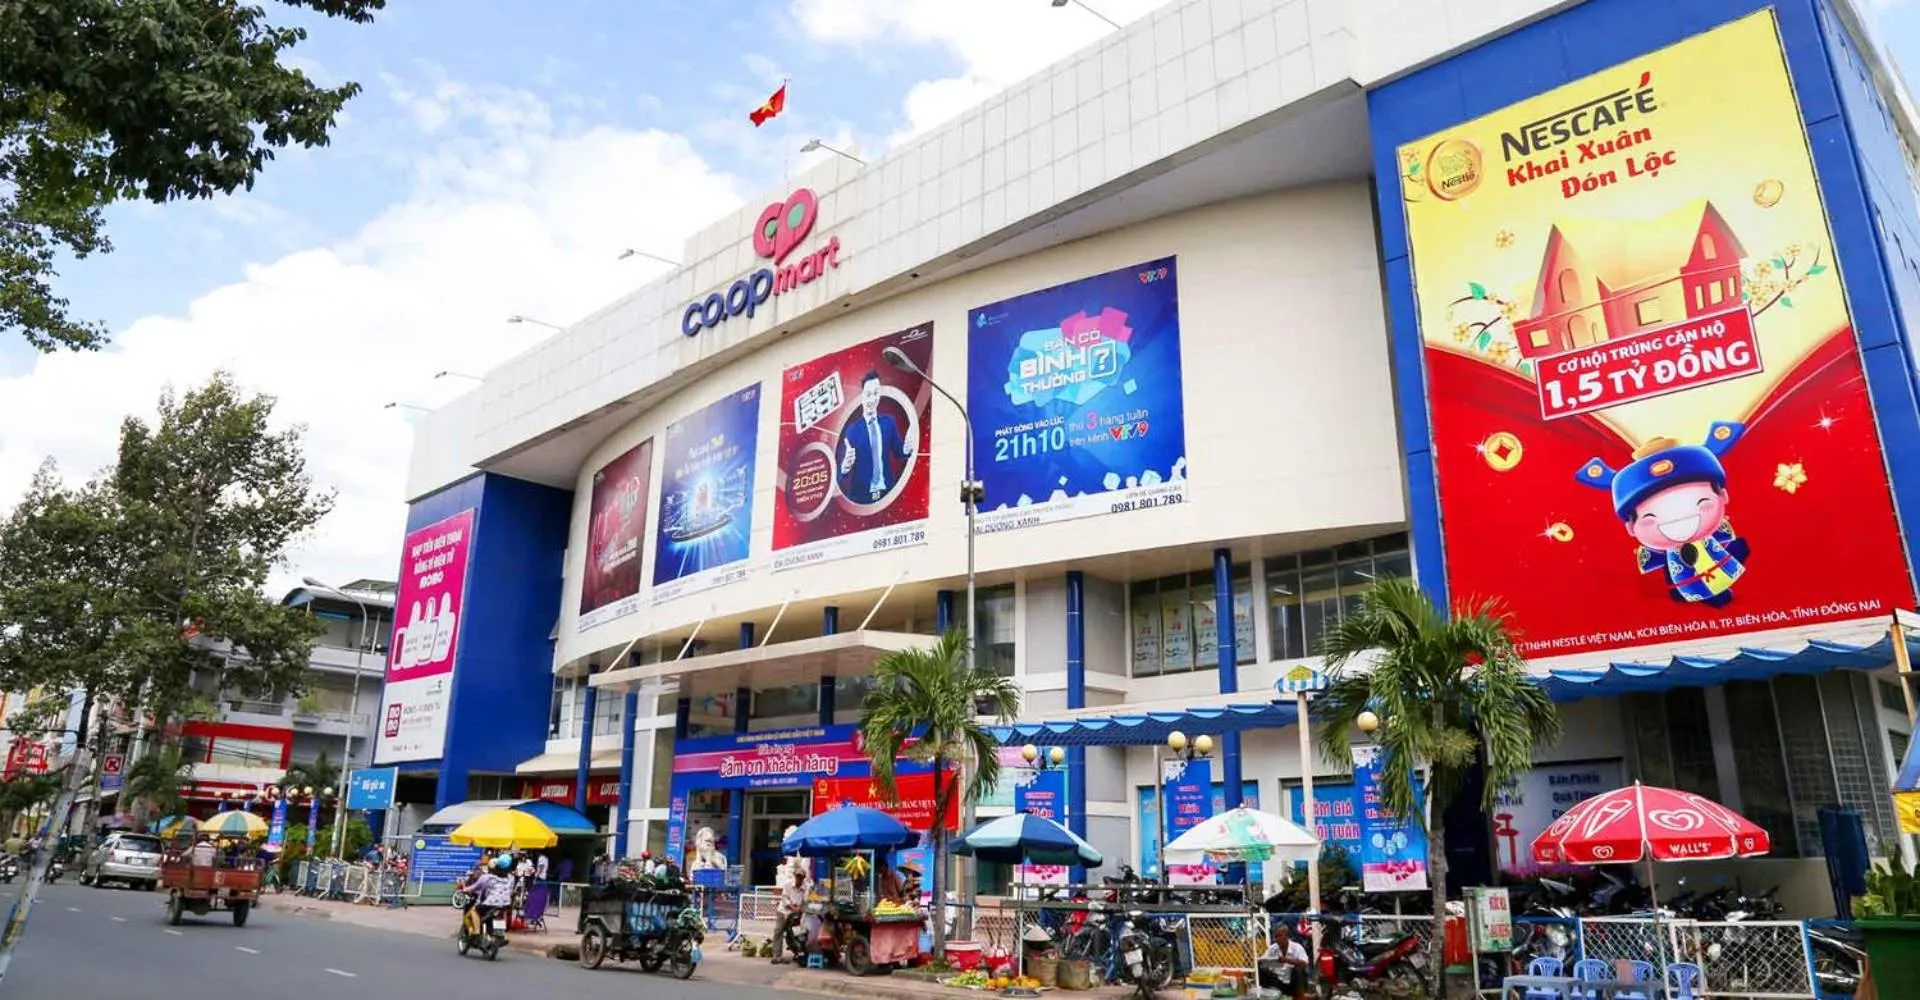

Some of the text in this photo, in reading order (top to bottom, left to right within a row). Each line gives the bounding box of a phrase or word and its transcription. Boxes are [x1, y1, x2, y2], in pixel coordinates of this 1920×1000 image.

[1500, 71, 1658, 162] NESCAFÉ
[1506, 127, 1652, 187] Khai Xuân
[1561, 149, 1677, 199] Đón Lộc
[1020, 346, 1086, 380] BÌNH
[1557, 319, 1726, 374] CƠ HỘI TRÚNG CĂN HỘ
[1546, 340, 1750, 409] 1,5 TỶ ĐỒNG
[995, 425, 1013, 437] PHÁT
[1087, 411, 1098, 430] 3
[995, 426, 1065, 462] 21h10
[792, 470, 828, 490] 20:05
[1525, 638, 1551, 651] TNHH
[1586, 632, 1608, 645] VIỆT
[1637, 626, 1658, 638] KCN
[1658, 622, 1682, 636] BIÊN
[1736, 612, 1761, 626] BIÊN
[1858, 599, 1881, 612] NAI
[766, 755, 802, 775] khách
[803, 752, 839, 776] hàng
[1669, 842, 1711, 854] WALL'S
